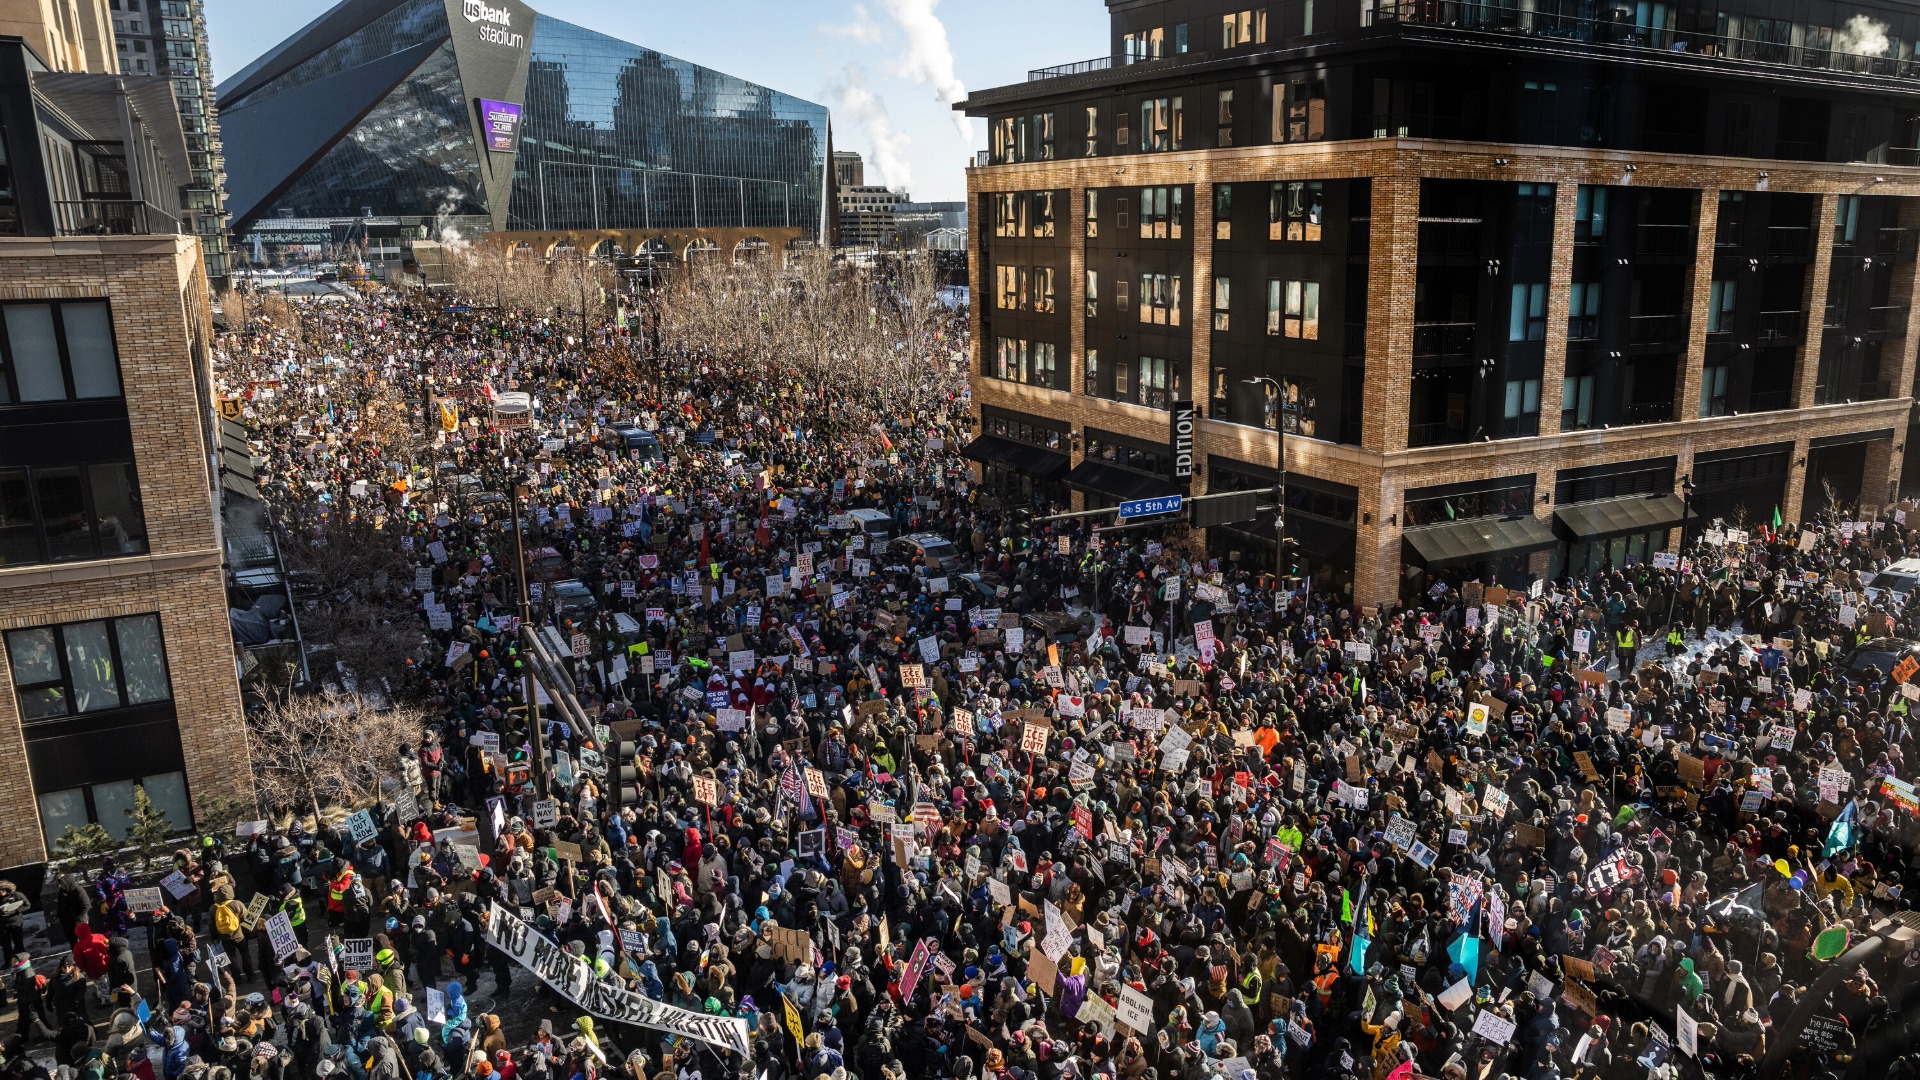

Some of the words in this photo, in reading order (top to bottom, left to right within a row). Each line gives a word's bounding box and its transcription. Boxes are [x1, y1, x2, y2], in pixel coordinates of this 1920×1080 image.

[479, 24, 523, 48] stadium
[487, 112, 518, 124] SUMMER
[492, 122, 513, 132] SLAM
[1176, 409, 1193, 477] EDITION
[1134, 503, 1141, 512] S
[1145, 500, 1164, 512] 5th
[1168, 499, 1180, 509] Av
[1196, 621, 1211, 630] ICE
[1196, 630, 1213, 639] OUT!
[574, 638, 588, 646] ICE
[656, 651, 671, 659] STOP
[1140, 654, 1158, 662] ICE
[796, 663, 812, 671] ICE
[903, 670, 920, 678] ICE
[904, 677, 922, 685] OUT!
[956, 714, 970, 724] ICE
[1135, 708, 1160, 718] BRING
[956, 722, 972, 734] OUT!
[1134, 722, 1164, 730] HOME!
[1776, 727, 1794, 735] NO
[1025, 730, 1044, 740] ICE
[786, 740, 810, 752] IE
[1024, 739, 1044, 752] OUT!
[808, 772, 822, 784] ICE
[696, 780, 714, 791] ICE
[810, 783, 826, 795] OUT!
[697, 790, 715, 801] OUT!
[536, 802, 553, 810] ONE
[350, 812, 365, 824] ICE
[536, 809, 554, 818] WAY
[352, 820, 368, 832] OUT
[356, 828, 373, 841] NOW
[130, 902, 162, 912] HUMANS
[268, 912, 285, 930] ICE
[270, 923, 288, 940] OUT
[622, 932, 640, 940] HATE
[778, 928, 802, 946] ICE
[275, 933, 292, 948] FOR
[346, 940, 371, 953] STOP
[499, 906, 529, 956] NO
[532, 938, 583, 996] MORE
[774, 942, 806, 960] OUT
[1120, 993, 1150, 1016] ABOLISH
[1128, 1010, 1139, 1022] ICE
[1482, 1012, 1510, 1030] RESIST
[1823, 1020, 1844, 1033] Nazis
[1296, 1030, 1308, 1044] OUT
